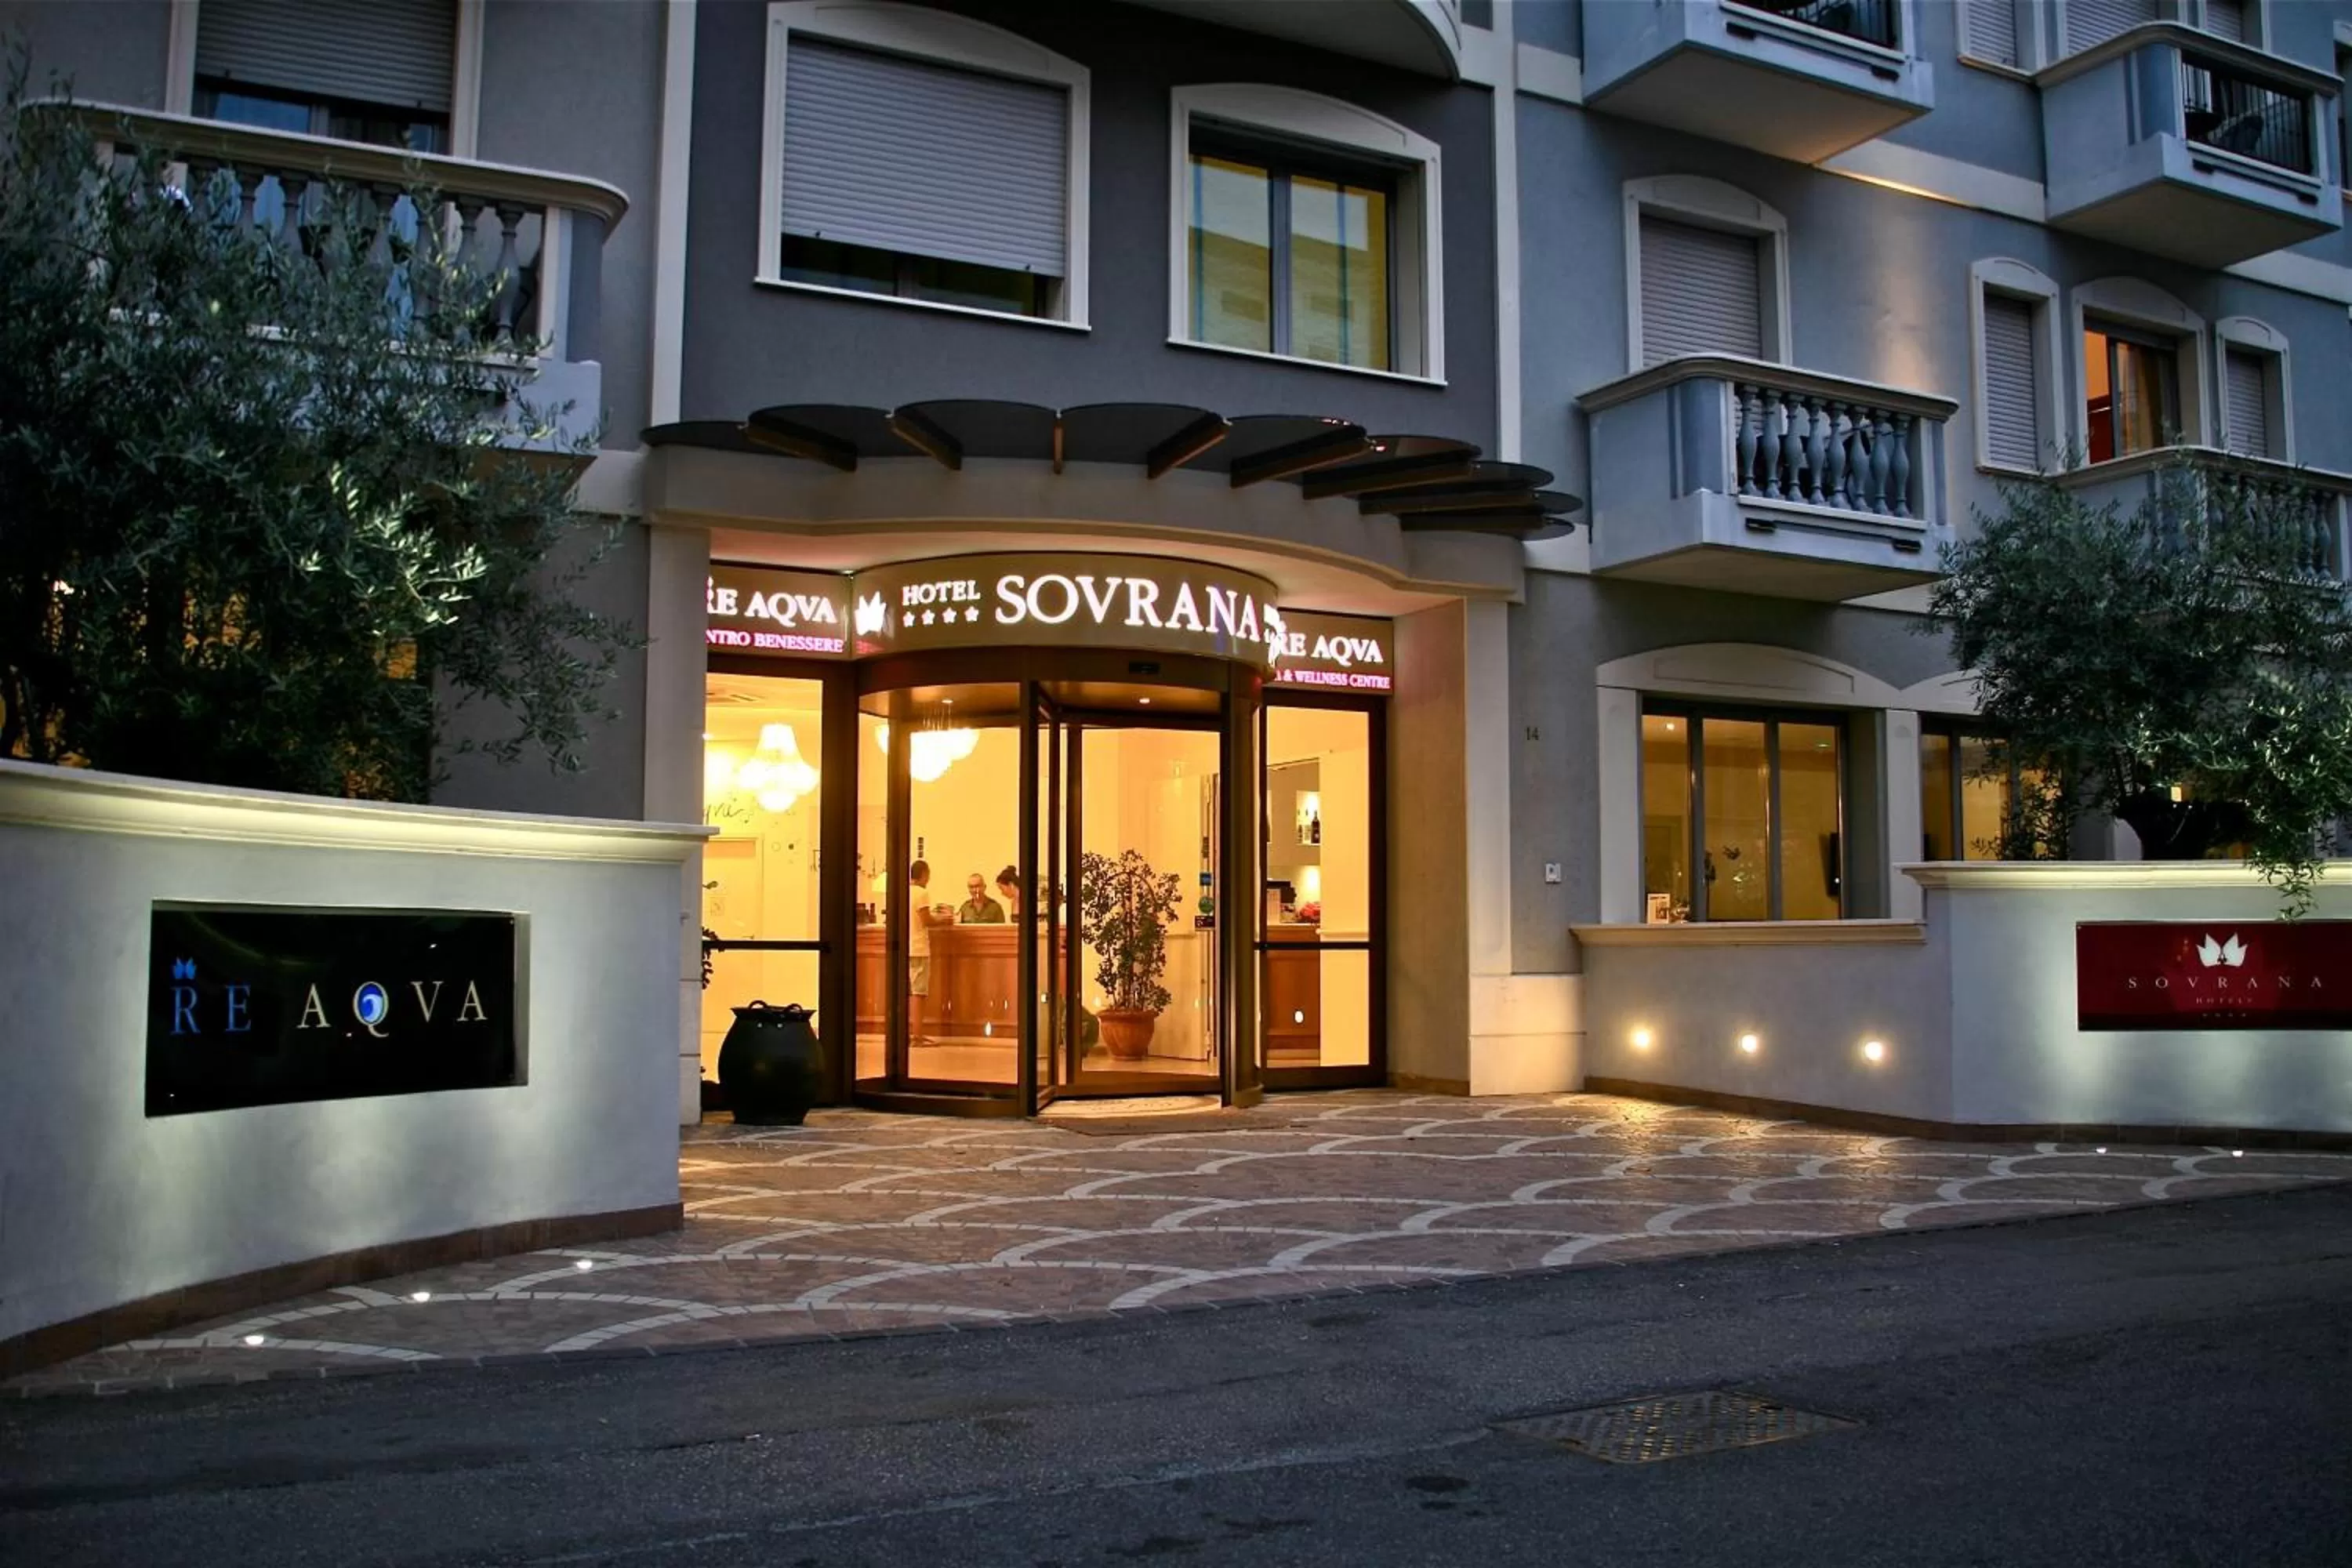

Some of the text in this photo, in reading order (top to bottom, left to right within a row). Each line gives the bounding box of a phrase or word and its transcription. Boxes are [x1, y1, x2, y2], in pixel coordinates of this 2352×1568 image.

[744, 590, 837, 627] AQVA
[902, 574, 1260, 644] HOTEL SOVRANA
[706, 630, 844, 653] NTRO BENESSERE
[1310, 634, 1384, 666] AQVA
[1283, 669, 1293, 681] &
[1294, 670, 1348, 686] WELLNESS
[1349, 674, 1391, 689] CENTRE
[2128, 977, 2322, 989] SOVRANA
[170, 980, 488, 1037] RE AQVA
